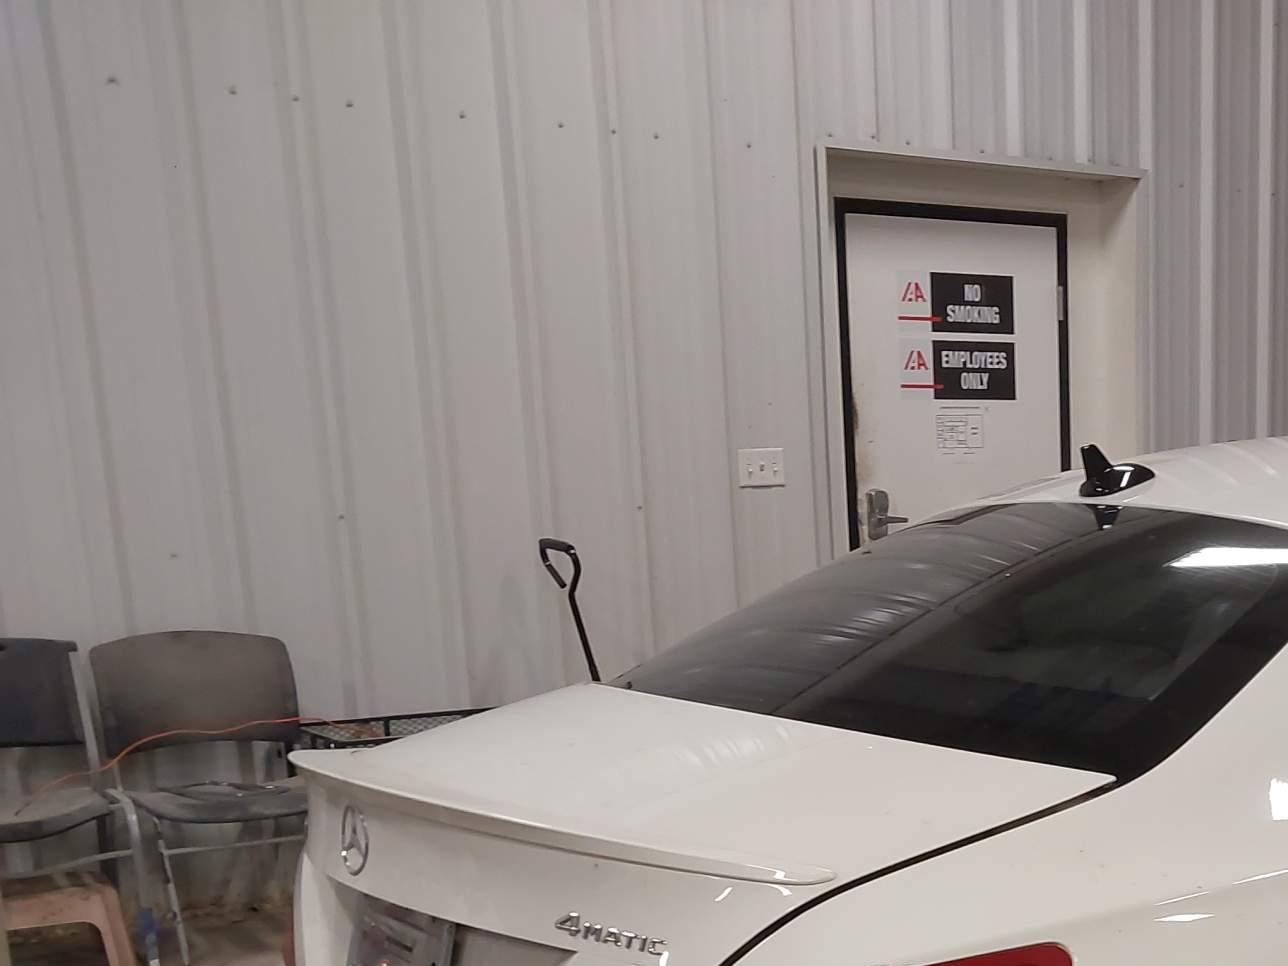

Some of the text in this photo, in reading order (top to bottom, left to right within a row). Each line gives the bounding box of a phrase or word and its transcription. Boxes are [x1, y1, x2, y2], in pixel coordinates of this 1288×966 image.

[964, 284, 981, 301] NO
[946, 304, 1000, 323] SMOKING
[941, 350, 1007, 369] EMPLOYEES
[960, 373, 989, 390] ONLY
[554, 911, 669, 956] 4MATIC
